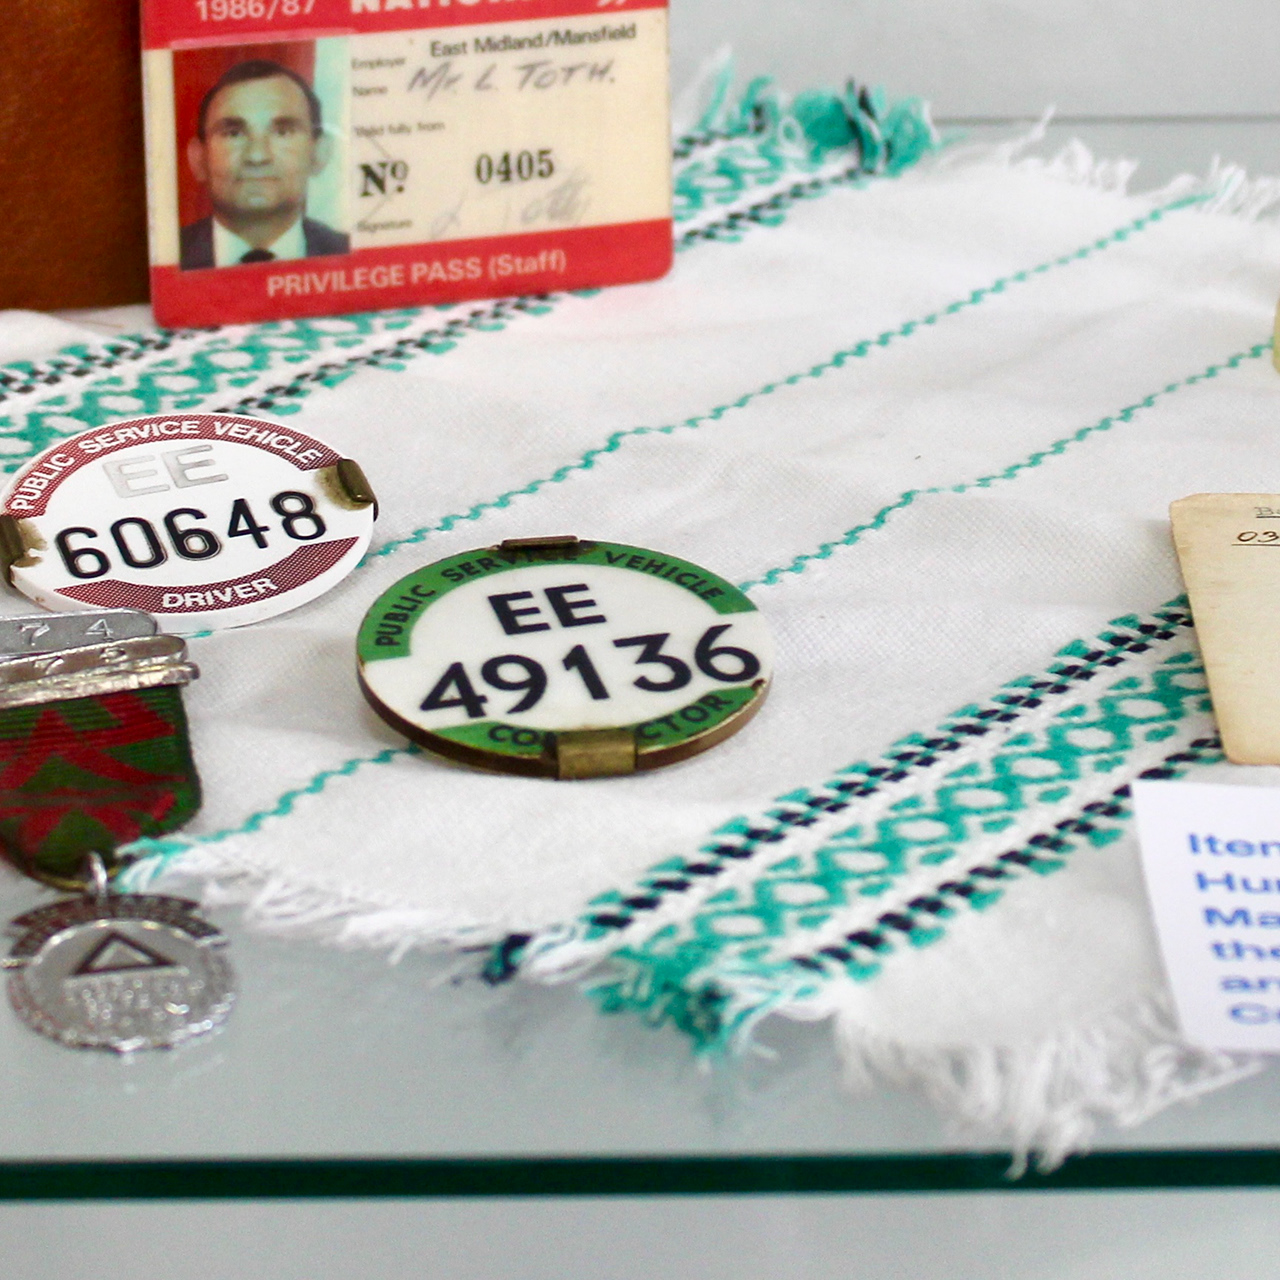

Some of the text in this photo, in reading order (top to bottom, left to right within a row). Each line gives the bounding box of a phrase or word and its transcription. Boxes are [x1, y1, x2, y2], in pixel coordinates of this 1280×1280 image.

[430, 23, 637, 57] East Midland/Mansfield
[475, 149, 556, 185] 0405
[267, 249, 567, 299] PRIVILEGE PASS (Staff)
[11, 420, 324, 510] PUBLIC SERVICE VEHICLE
[103, 445, 229, 498] EE
[54, 490, 326, 580] 60648
[162, 577, 278, 608] DRIVER
[375, 584, 436, 647] PUBLIC
[605, 550, 724, 601] VEHICLE
[487, 584, 607, 635] EE
[420, 624, 760, 719] 49136
